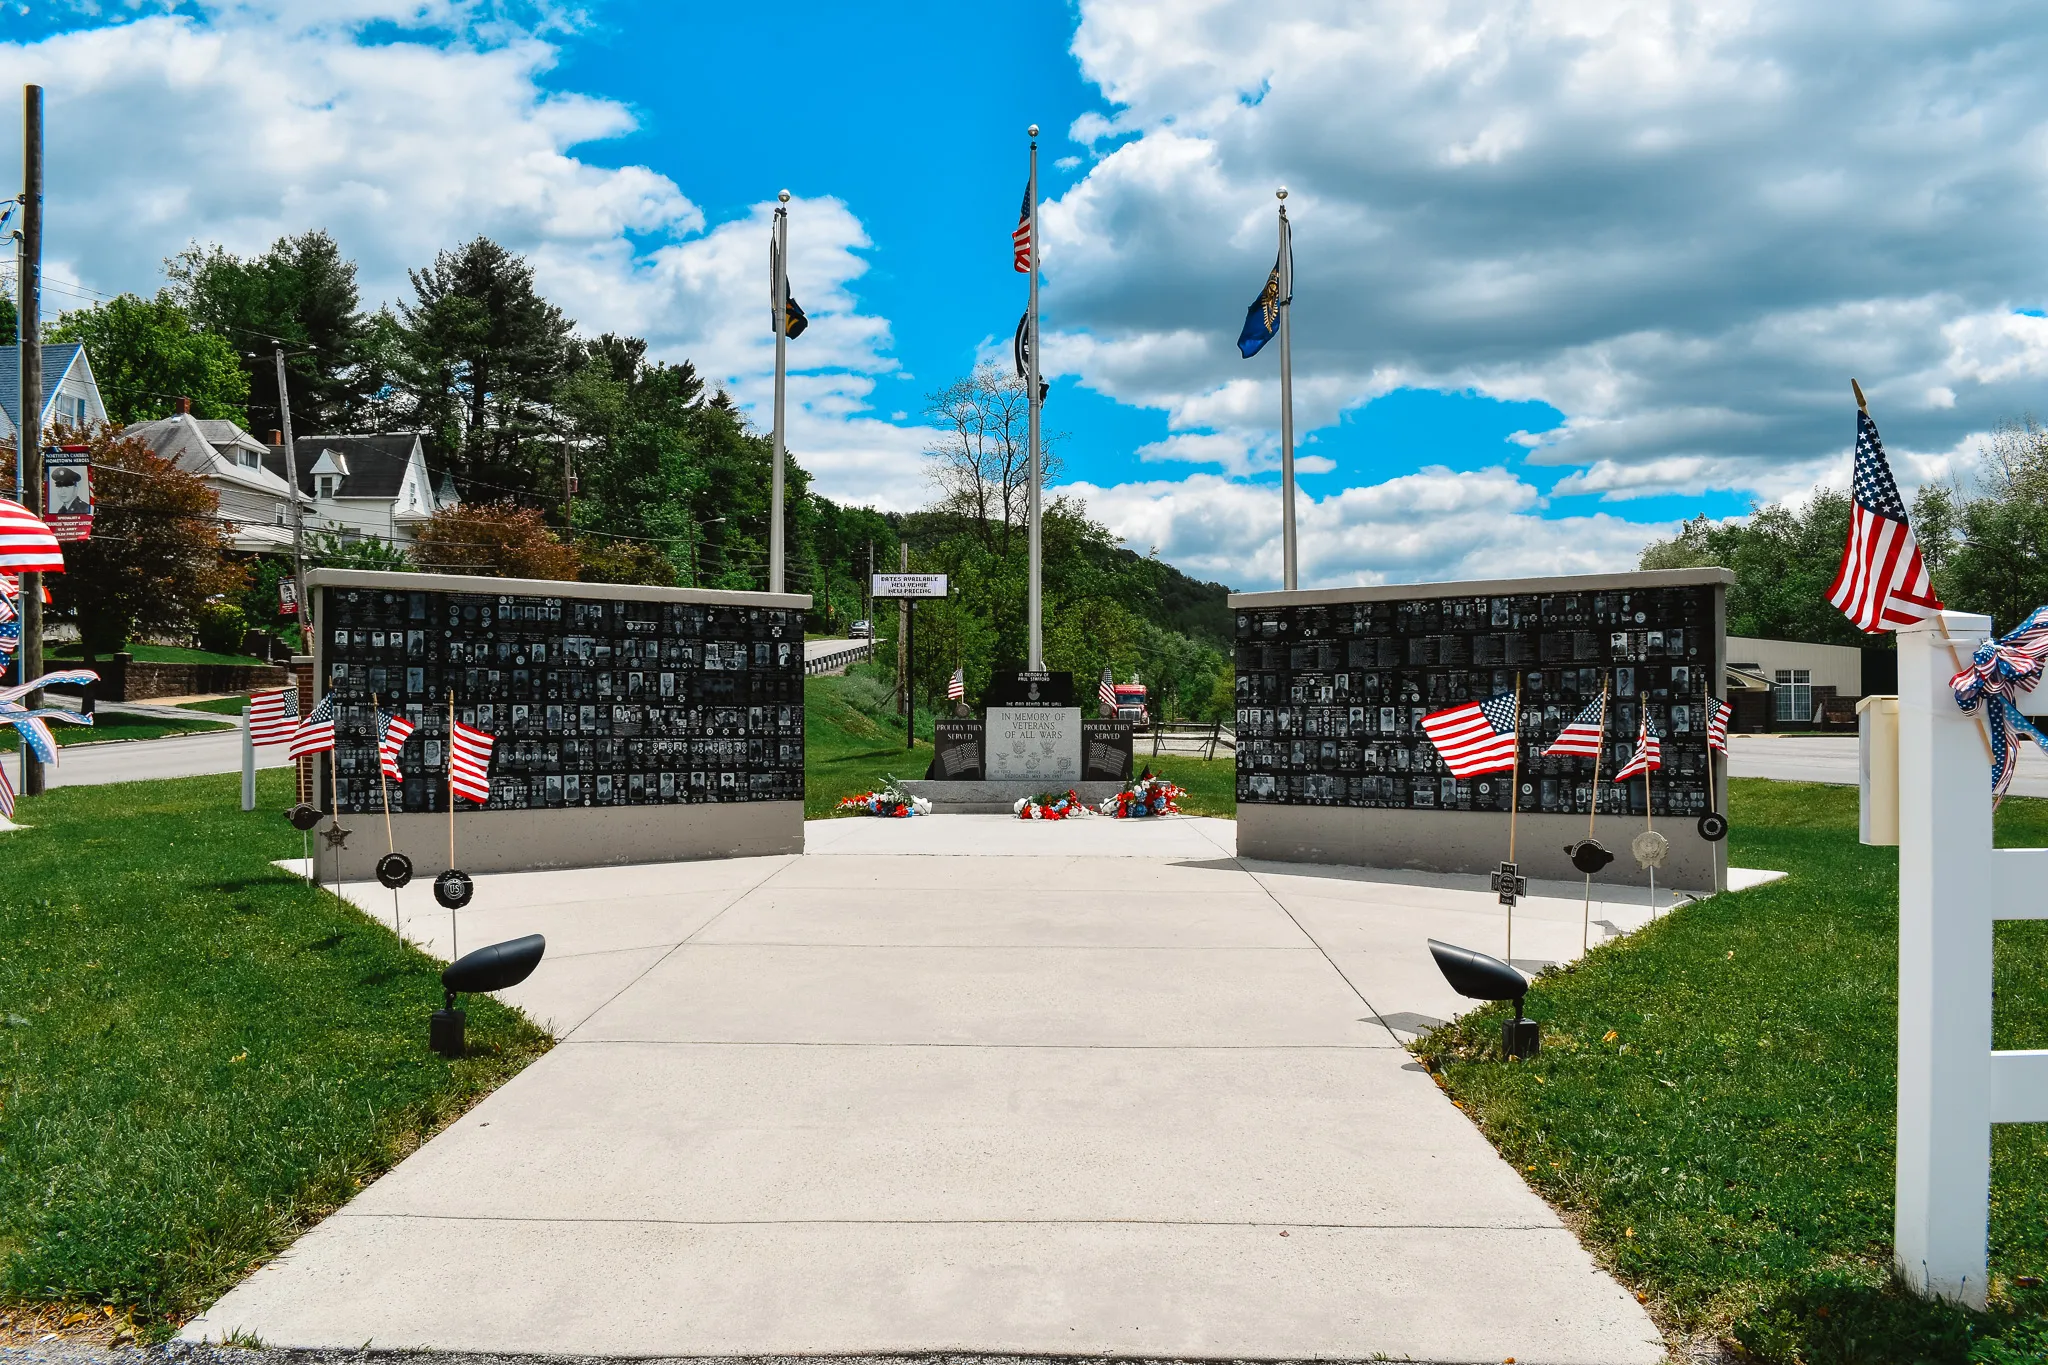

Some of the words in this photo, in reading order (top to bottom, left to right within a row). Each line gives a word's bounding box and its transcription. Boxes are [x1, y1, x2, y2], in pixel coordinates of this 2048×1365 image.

[1001, 713, 1011, 721] IN
[1014, 713, 1051, 721] MEMORY
[1012, 722, 1056, 730] VETERANS
[1004, 731, 1016, 739] OF
[1019, 731, 1036, 739] ALL
[1039, 731, 1063, 739] WARS
